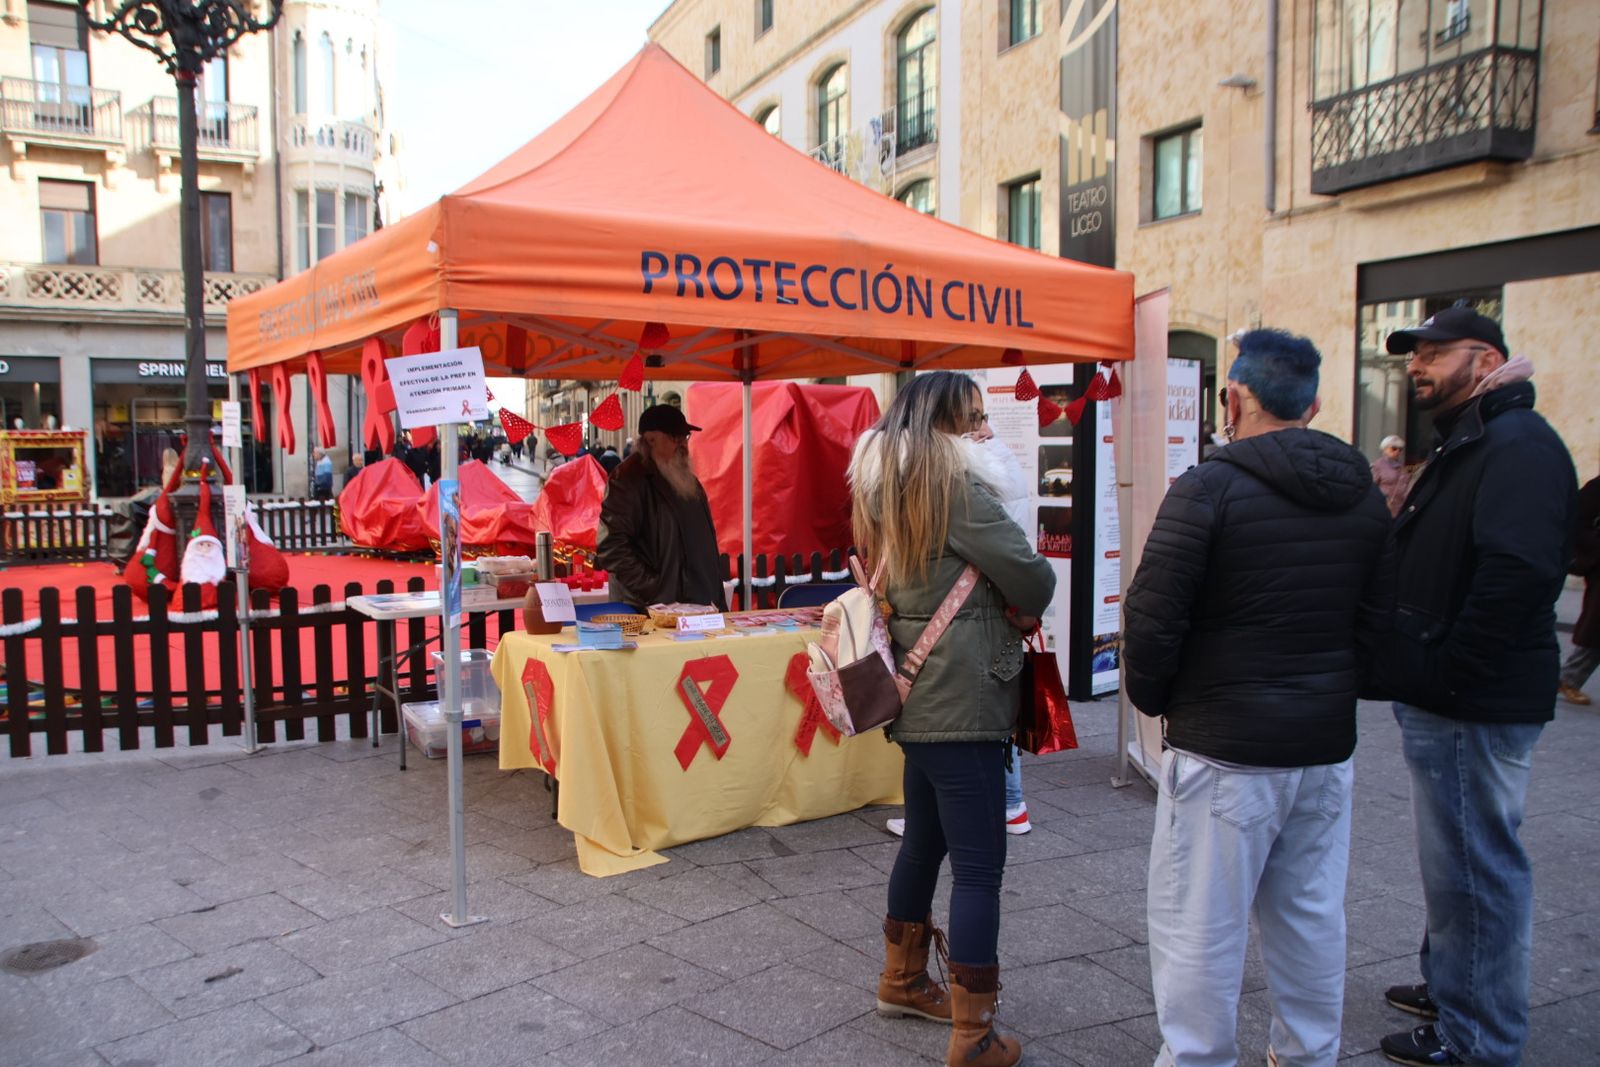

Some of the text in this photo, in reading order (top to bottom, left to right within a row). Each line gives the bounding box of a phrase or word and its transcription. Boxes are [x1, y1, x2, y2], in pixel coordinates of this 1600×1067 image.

[1067, 185, 1108, 213] TEATRO
[1071, 211, 1102, 238] LICEO
[641, 251, 1034, 329] PROTECCIÓN CIVIL
[138, 362, 228, 377] SPRINIEL
[407, 361, 463, 373] IMPLEMENTACIÓN
[399, 377, 430, 387] EFECTIVA
[450, 372, 466, 380] PREP
[409, 384, 472, 398] ATENCIÓN PRIMARIA
